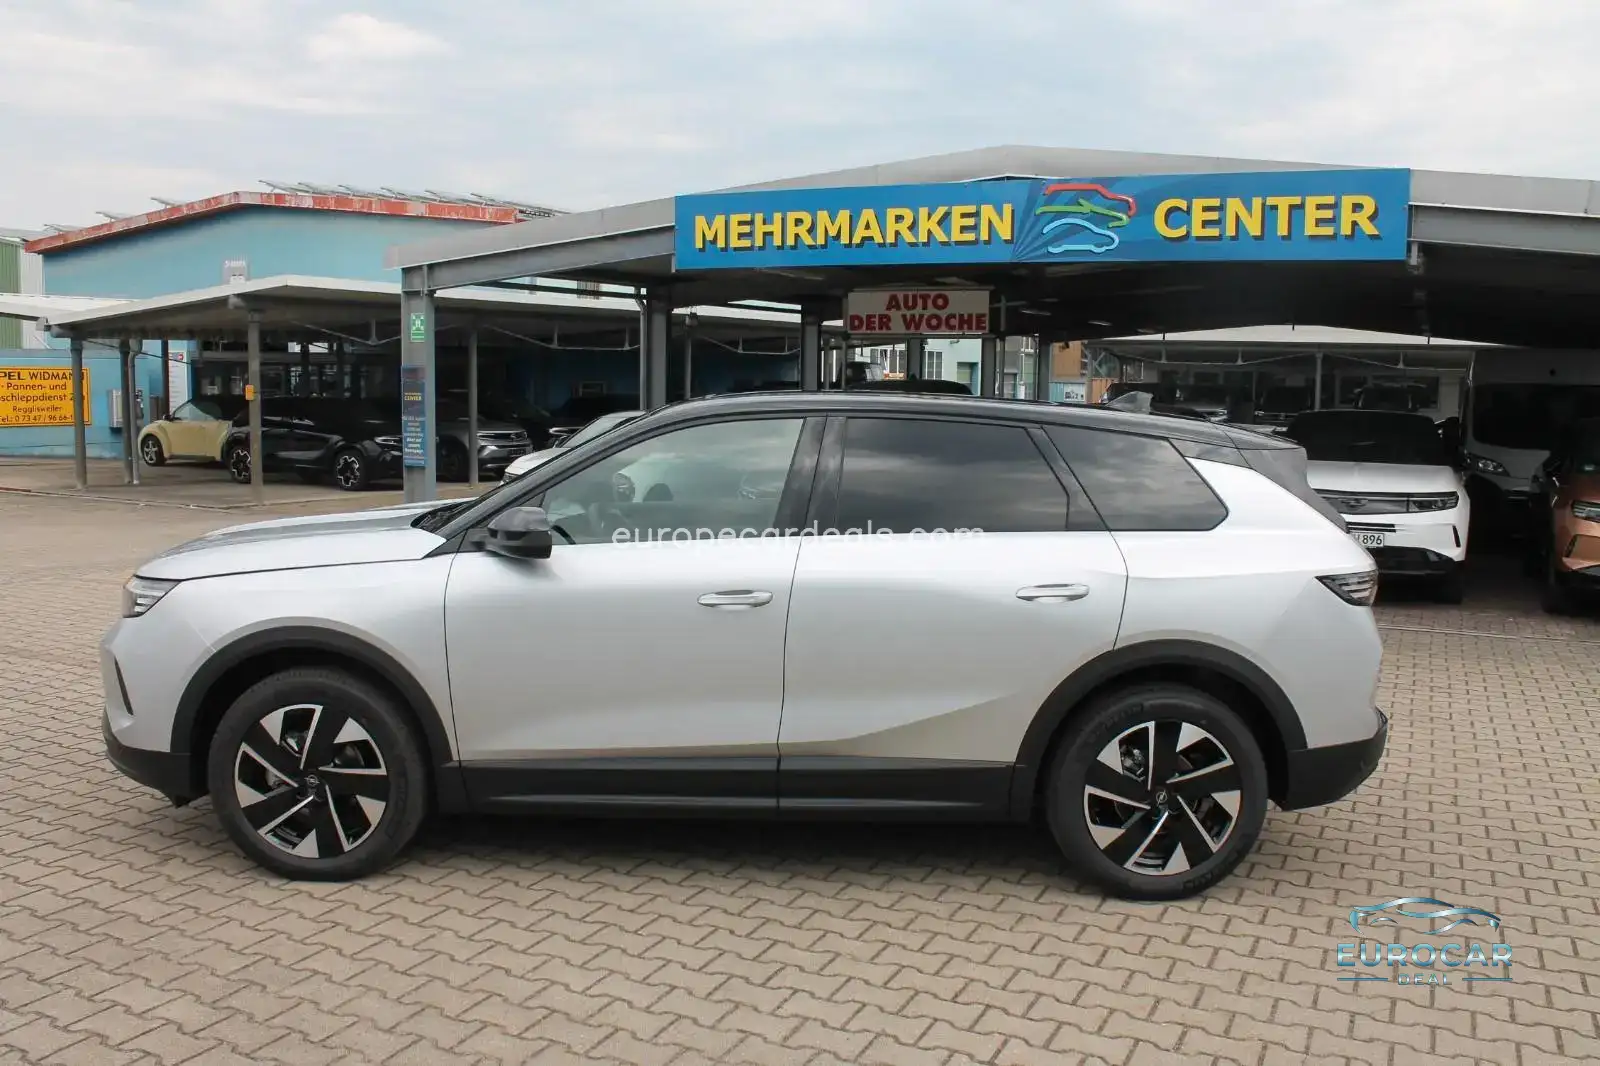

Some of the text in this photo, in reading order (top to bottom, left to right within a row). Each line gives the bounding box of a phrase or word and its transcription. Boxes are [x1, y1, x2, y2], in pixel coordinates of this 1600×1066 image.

[694, 194, 1382, 252] MEHRMARKEN CENTER
[885, 293, 950, 311] AUTO
[849, 313, 987, 331] DER WOCHE
[28, 371, 84, 380] WIDMA
[6, 381, 67, 390] Pannen- und
[0, 392, 67, 403] schleppdienst
[12, 405, 63, 413] Regglisweiler
[1362, 534, 1383, 545] 896
